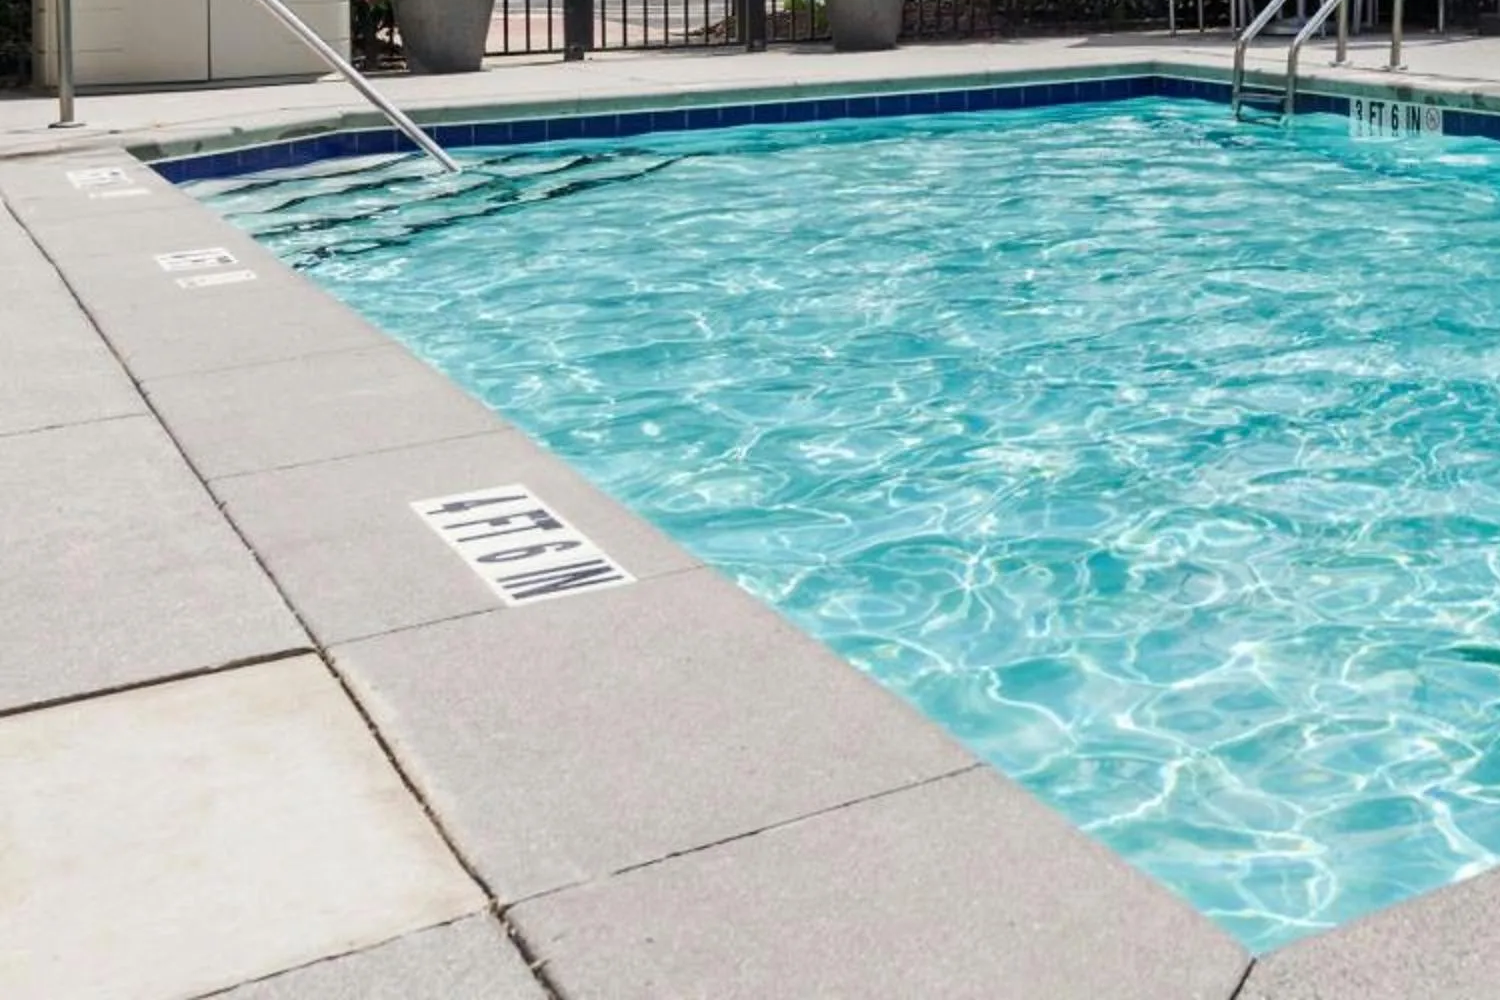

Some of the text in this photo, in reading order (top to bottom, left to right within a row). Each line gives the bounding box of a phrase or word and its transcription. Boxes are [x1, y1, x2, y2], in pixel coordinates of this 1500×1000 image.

[1355, 99, 1420, 131] 3 FT 6 IN
[425, 494, 625, 601] 4 FT 6 IN
